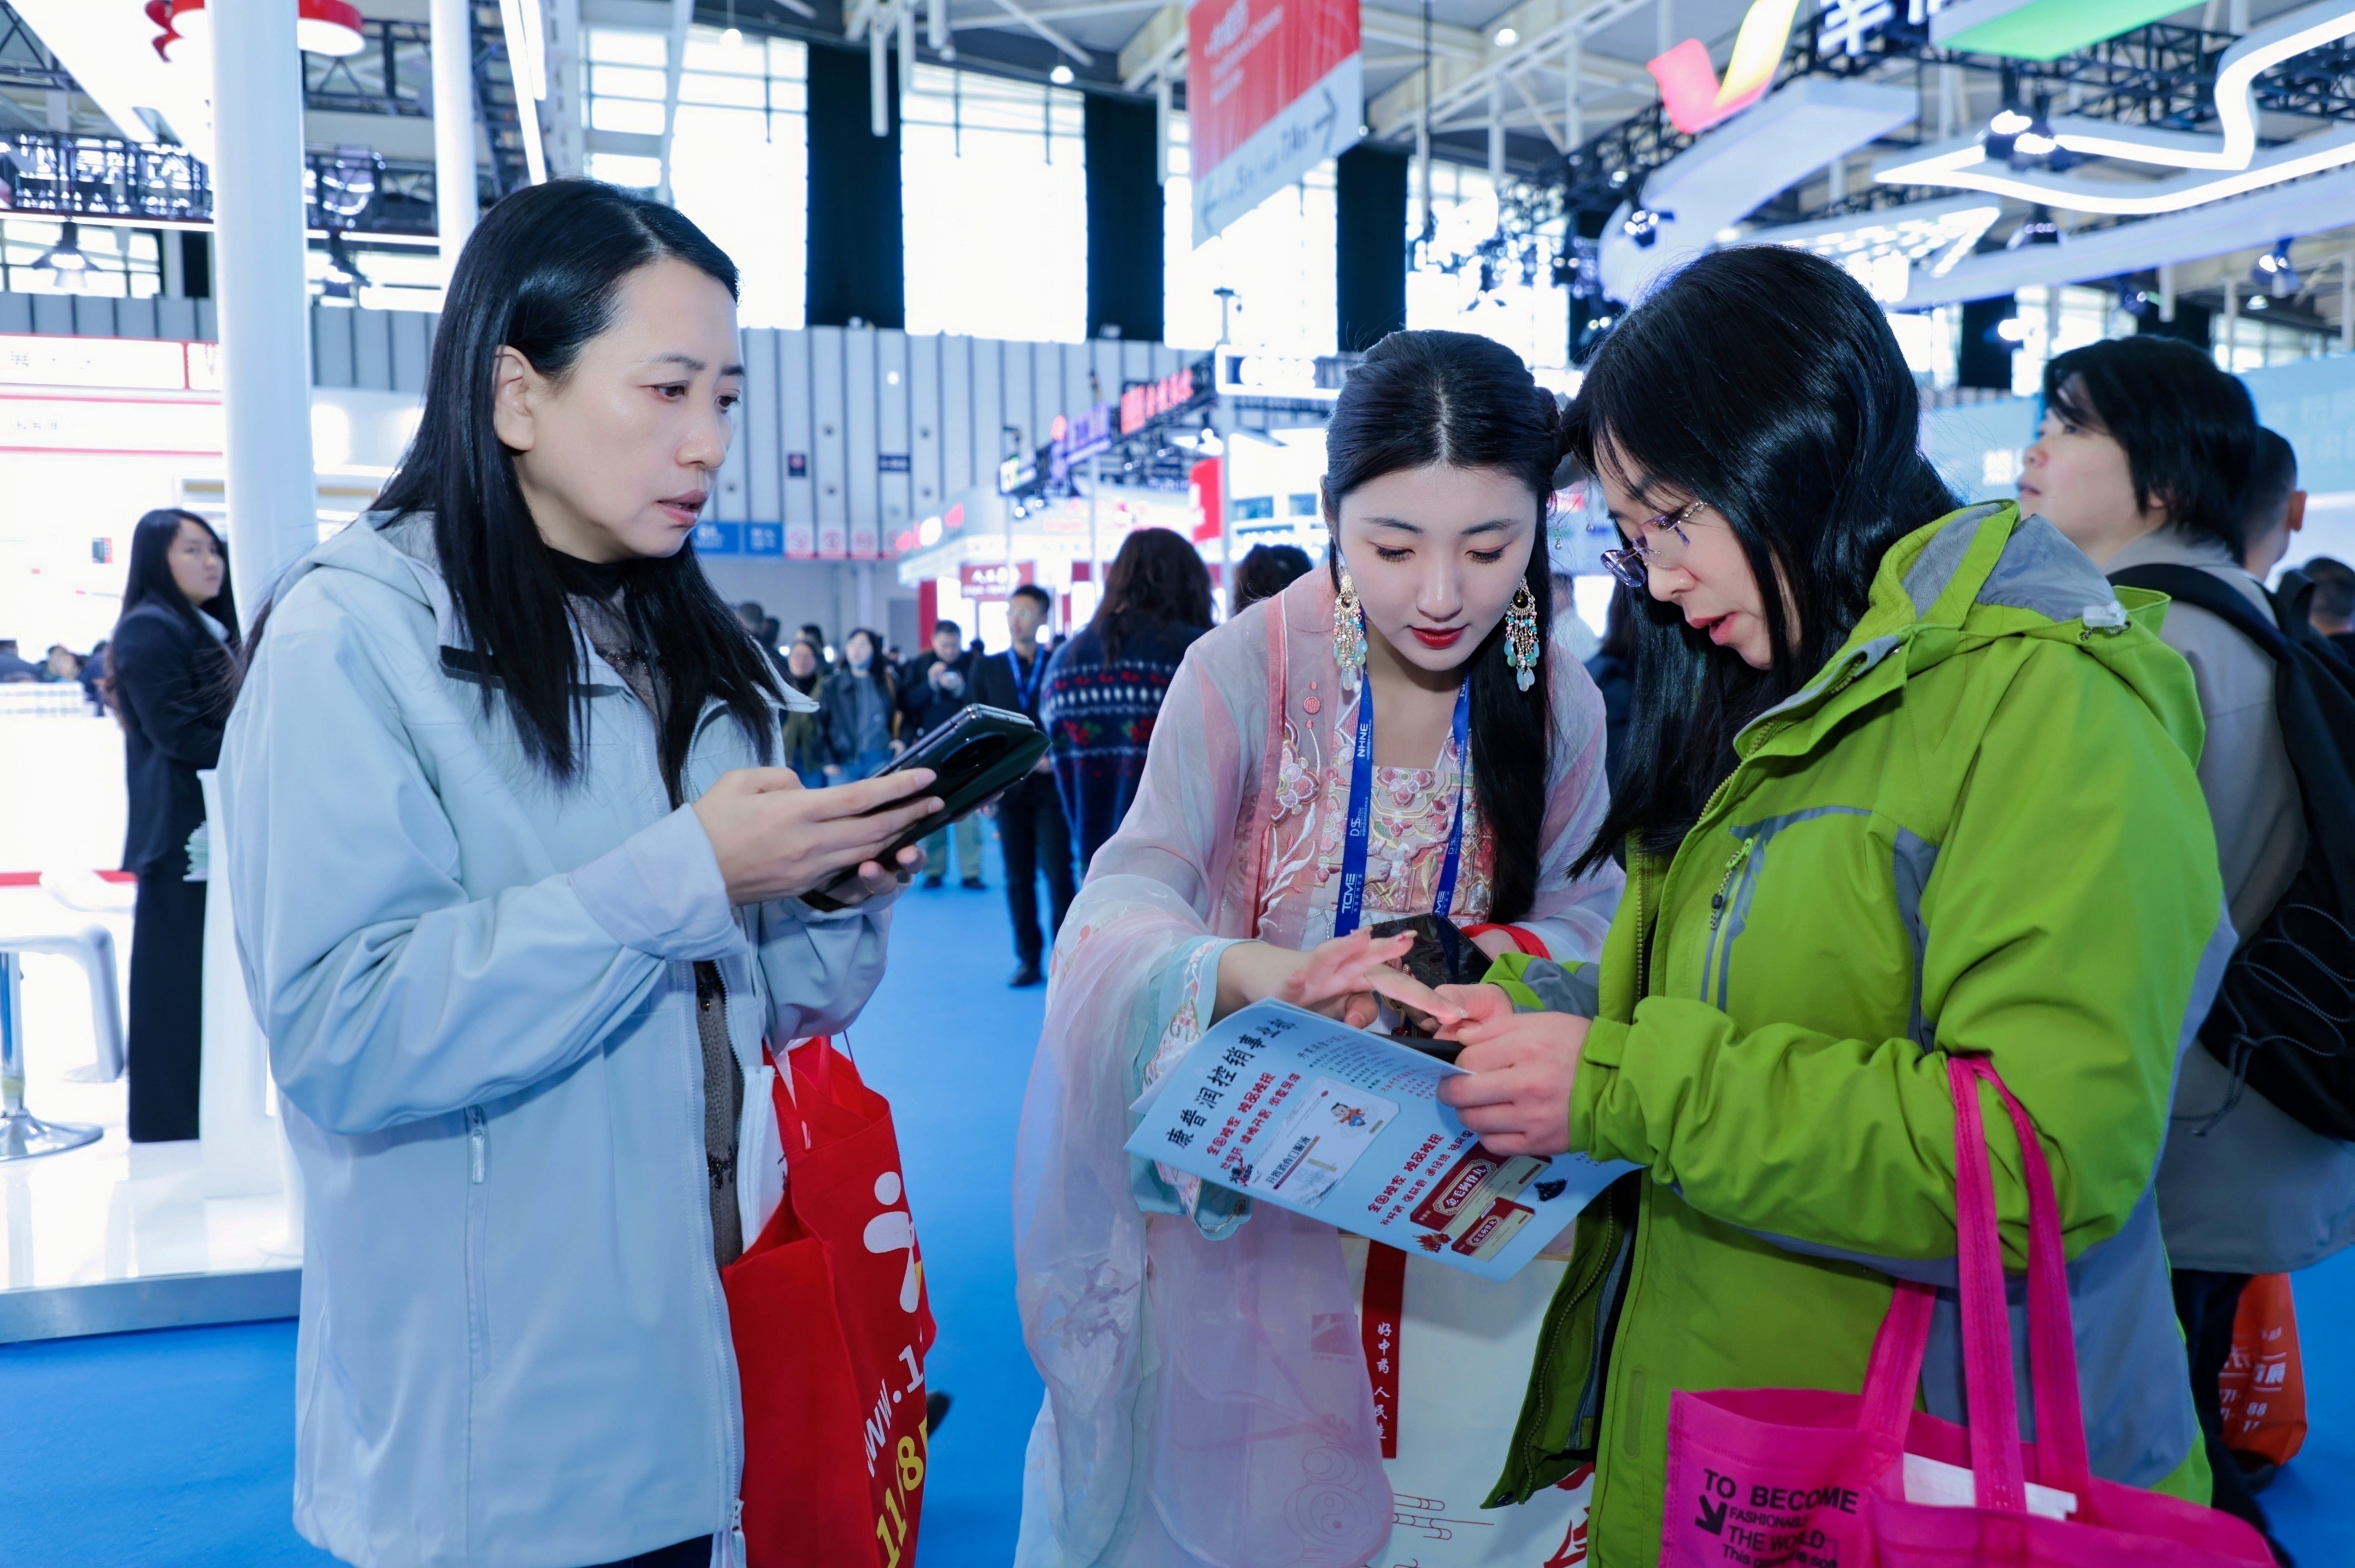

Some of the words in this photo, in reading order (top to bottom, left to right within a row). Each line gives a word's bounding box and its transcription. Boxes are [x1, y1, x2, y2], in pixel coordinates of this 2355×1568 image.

[1357, 722, 1368, 757] NHNE
[1342, 872, 1356, 913] TCME
[1166, 1019, 1298, 1147] 康普润控销事业部
[1207, 1117, 1241, 1156] 全国独家
[1266, 1137, 1311, 1187] 开胃消食口服液
[1368, 1175, 1407, 1212] 全国独家
[1446, 1169, 1486, 1207] 金毛狗脊丸
[1473, 1220, 1497, 1241] 金毛狗脊丸
[1376, 1321, 1392, 1374] 好中药
[1703, 1467, 1737, 1499] TO
[1749, 1484, 1859, 1515] BECOME
[1729, 1506, 1809, 1528] FASHIONABL
[1722, 1543, 1751, 1565] This
[1728, 1524, 1766, 1552] THE
[1770, 1529, 1825, 1553] WOLD
